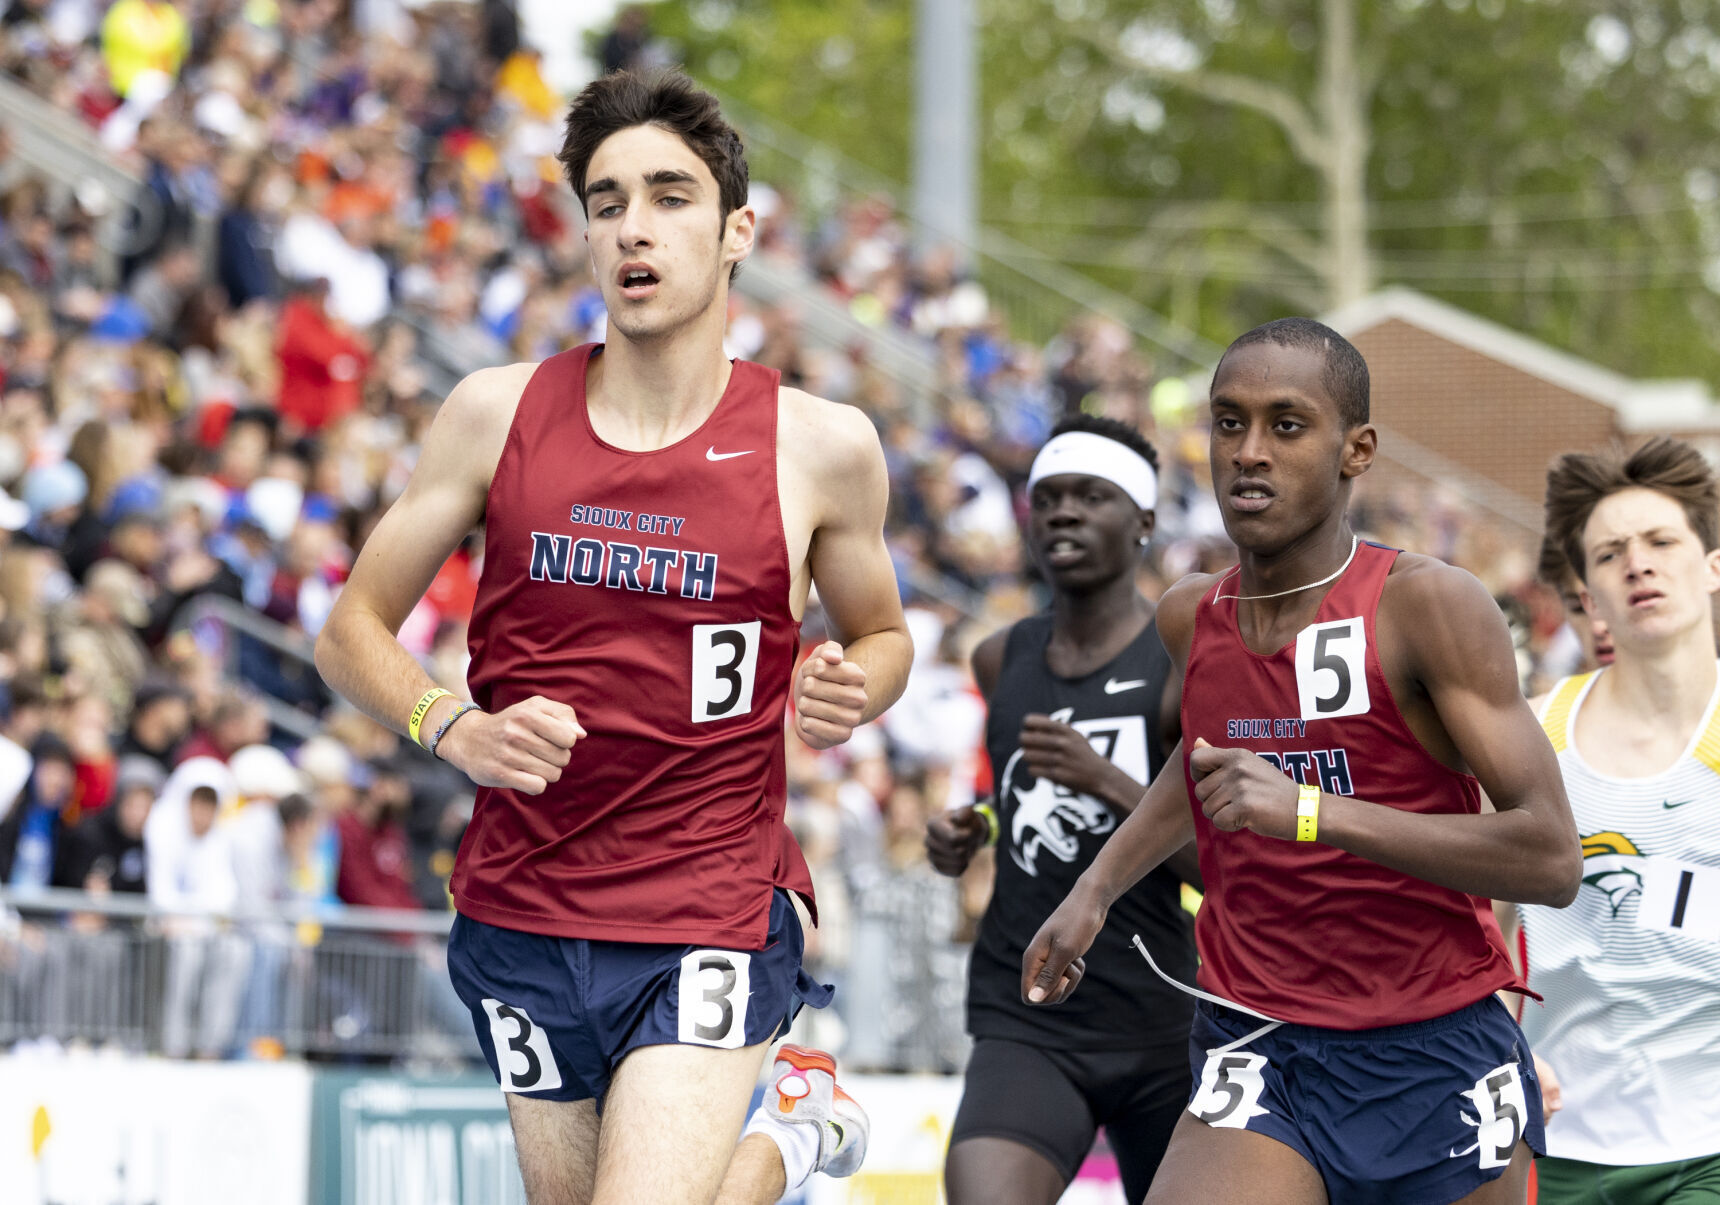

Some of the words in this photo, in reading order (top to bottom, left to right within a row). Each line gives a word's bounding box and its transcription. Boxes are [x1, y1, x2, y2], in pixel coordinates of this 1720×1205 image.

[570, 503, 633, 531] SIOUX
[636, 513, 685, 537] CITY
[529, 531, 719, 601] NORTH
[706, 629, 746, 716] 3
[1313, 625, 1351, 713] 5
[411, 691, 437, 727] STATE
[1227, 718, 1272, 739] SIOUX
[1274, 718, 1306, 738] CITY
[1670, 870, 1694, 928] 1
[694, 956, 737, 1041] 3
[496, 1004, 542, 1088] 3
[1200, 1057, 1252, 1123] 5
[1486, 1070, 1521, 1160] 5
